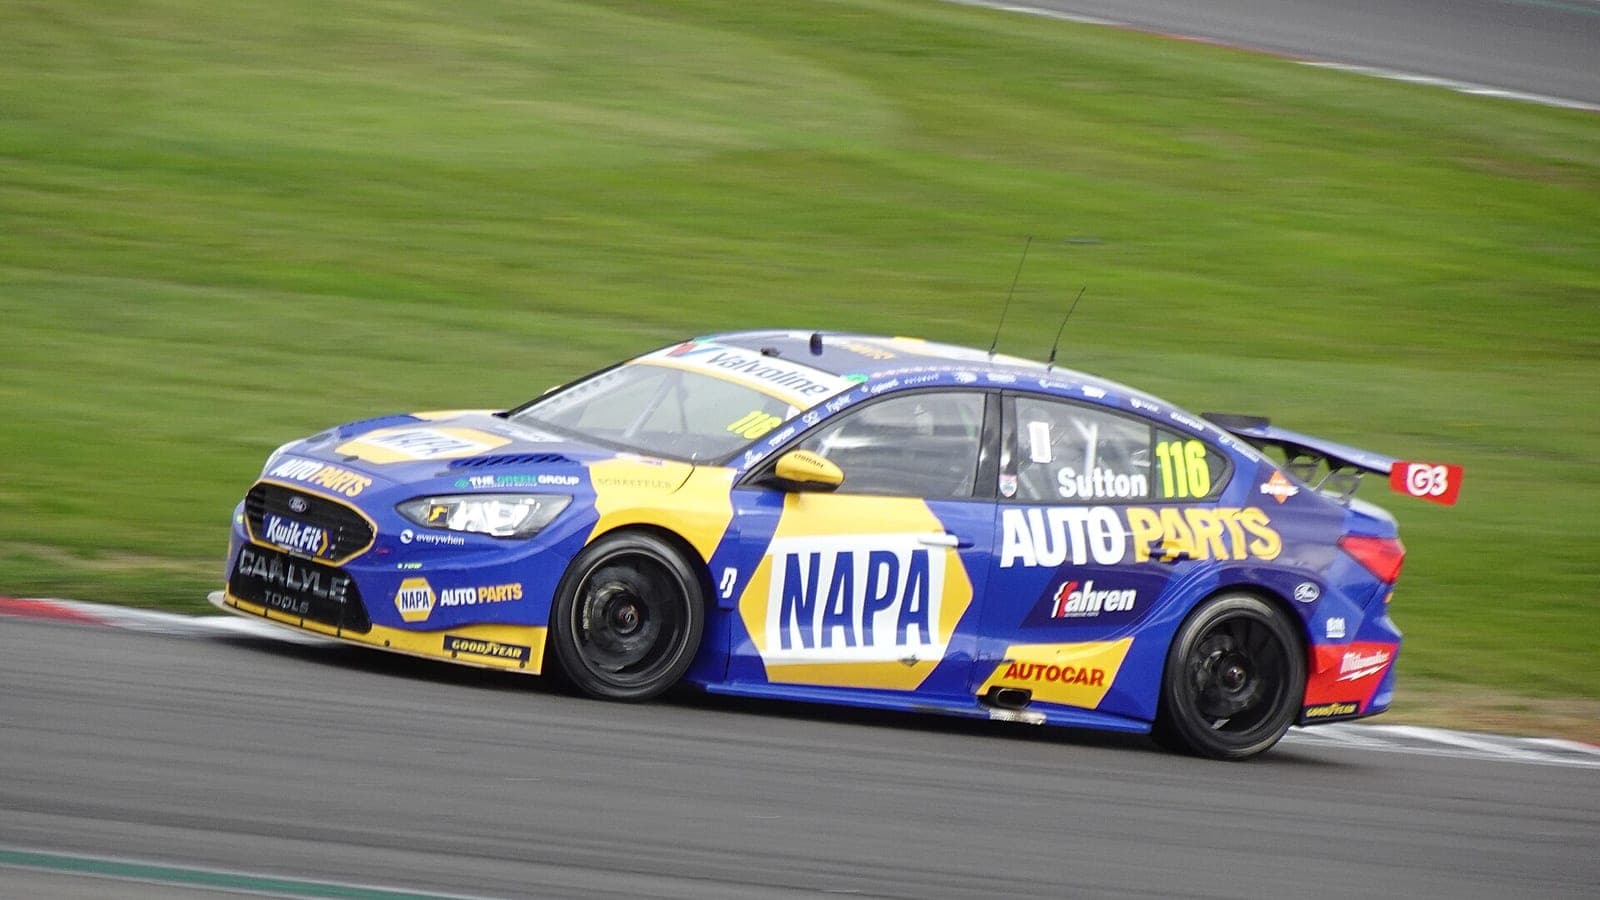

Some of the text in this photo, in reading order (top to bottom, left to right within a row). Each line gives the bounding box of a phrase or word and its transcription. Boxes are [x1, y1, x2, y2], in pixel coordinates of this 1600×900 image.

[706, 352, 830, 396] Valvoline
[726, 411, 783, 440] 116
[269, 458, 373, 497] AUTO PARTS
[469, 475, 495, 485] THE
[537, 475, 580, 487] GROUP
[1057, 466, 1148, 498] Sutton
[1155, 439, 1211, 498] 116
[1406, 463, 1449, 497] G3
[415, 532, 465, 546] everywhen
[1000, 506, 1282, 568] AUTO PARTS
[264, 590, 310, 613] TOOLS
[401, 590, 430, 610] NAPA
[440, 582, 524, 607] AUTO PARTS
[779, 549, 932, 650] NAPA
[1051, 580, 1137, 619] fahren
[1004, 662, 1105, 687] AUTOCAR
